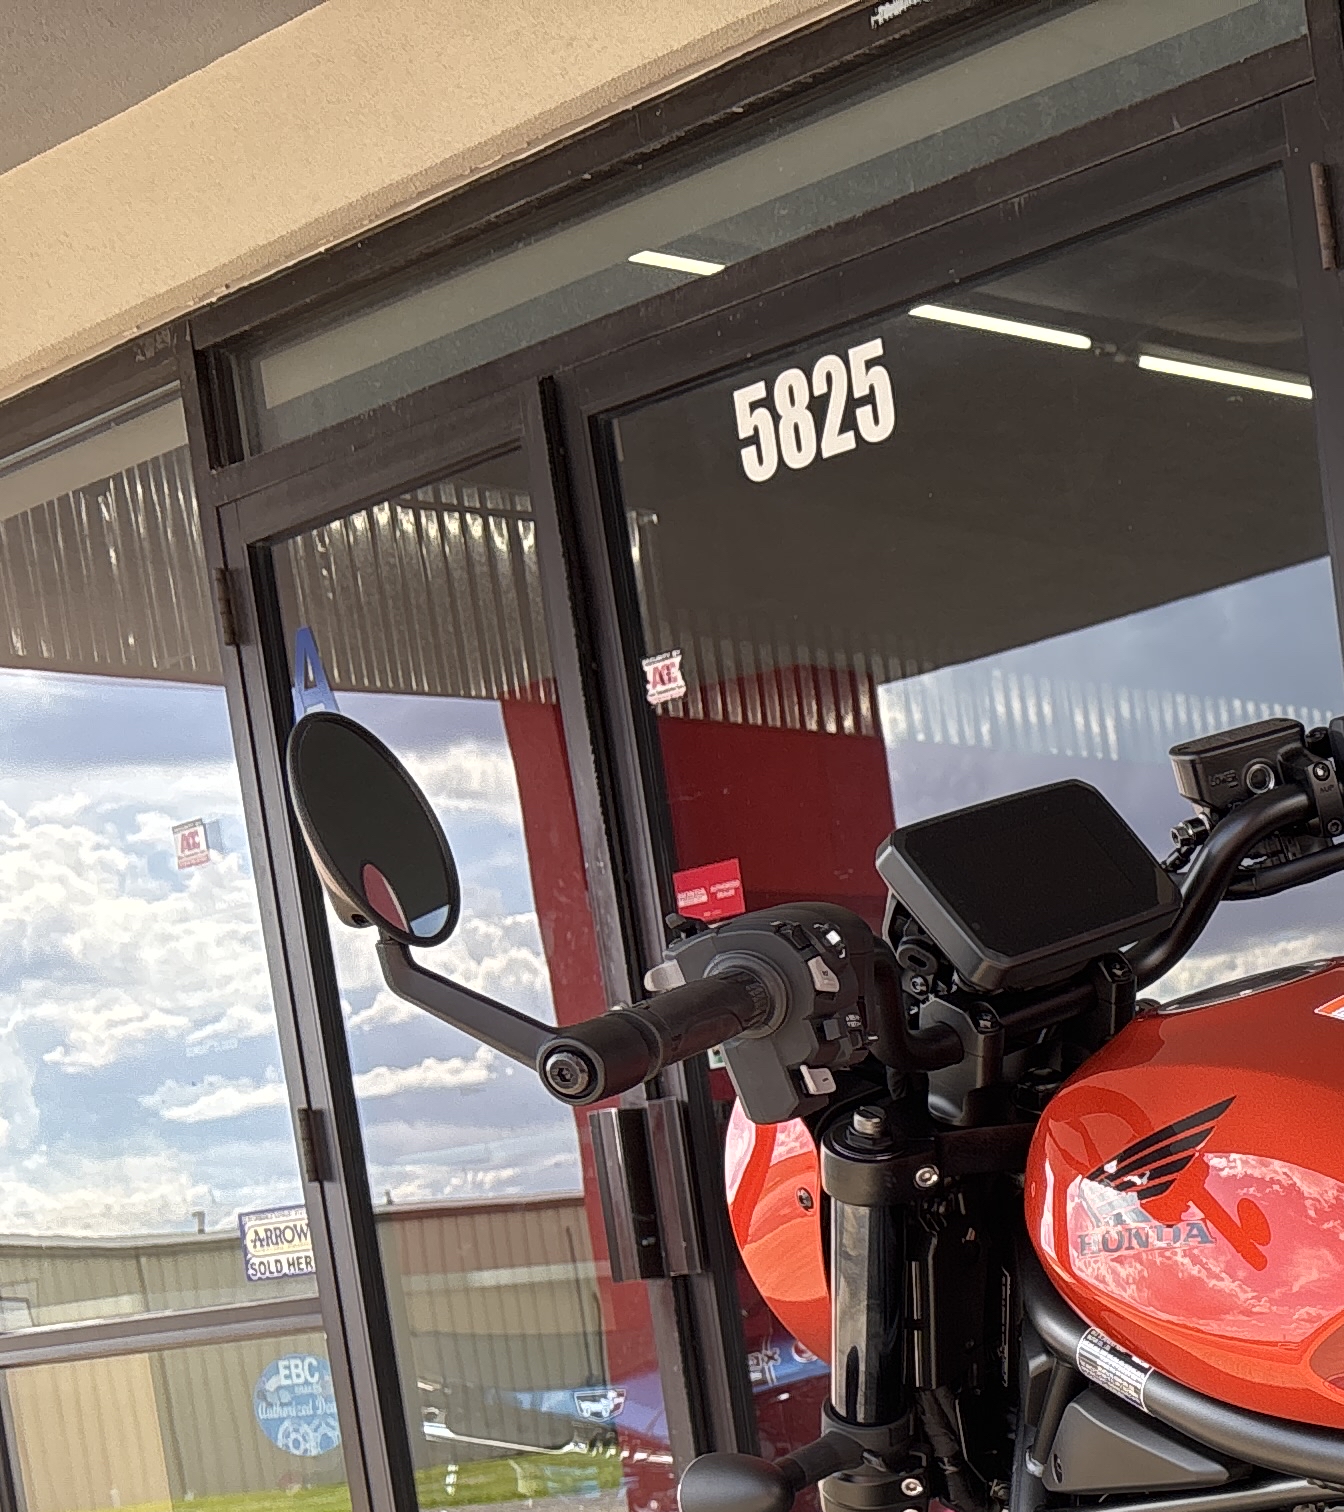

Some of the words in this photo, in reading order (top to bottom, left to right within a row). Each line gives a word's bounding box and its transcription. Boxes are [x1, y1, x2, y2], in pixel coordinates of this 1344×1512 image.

[733, 337, 895, 482] 5825
[250, 1223, 310, 1249] ARROW
[1078, 1222, 1217, 1257] HONDA
[250, 1259, 283, 1277] SOLD
[287, 1255, 313, 1273] HER
[278, 1357, 320, 1386] EBC
